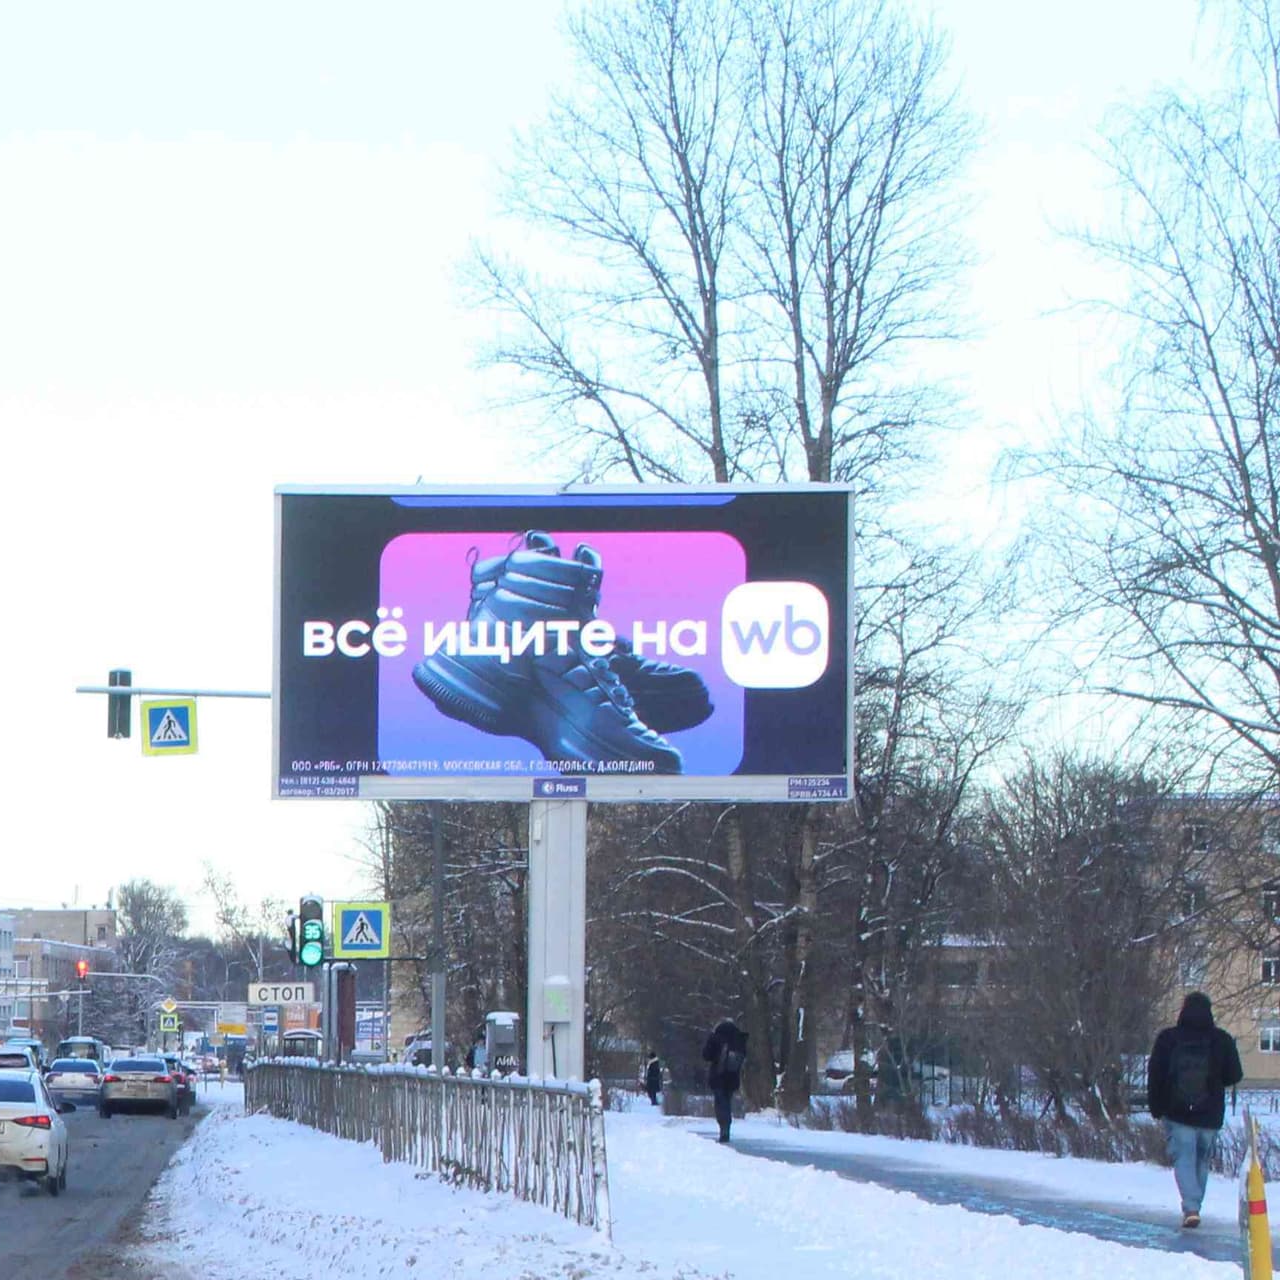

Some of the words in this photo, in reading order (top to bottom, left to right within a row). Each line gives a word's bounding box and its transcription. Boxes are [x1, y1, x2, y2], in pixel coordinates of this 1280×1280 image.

[303, 606, 408, 658] всё
[423, 618, 616, 664] ищите
[633, 618, 707, 657] на
[729, 604, 823, 655] wb
[257, 986, 305, 1001] СТОП
